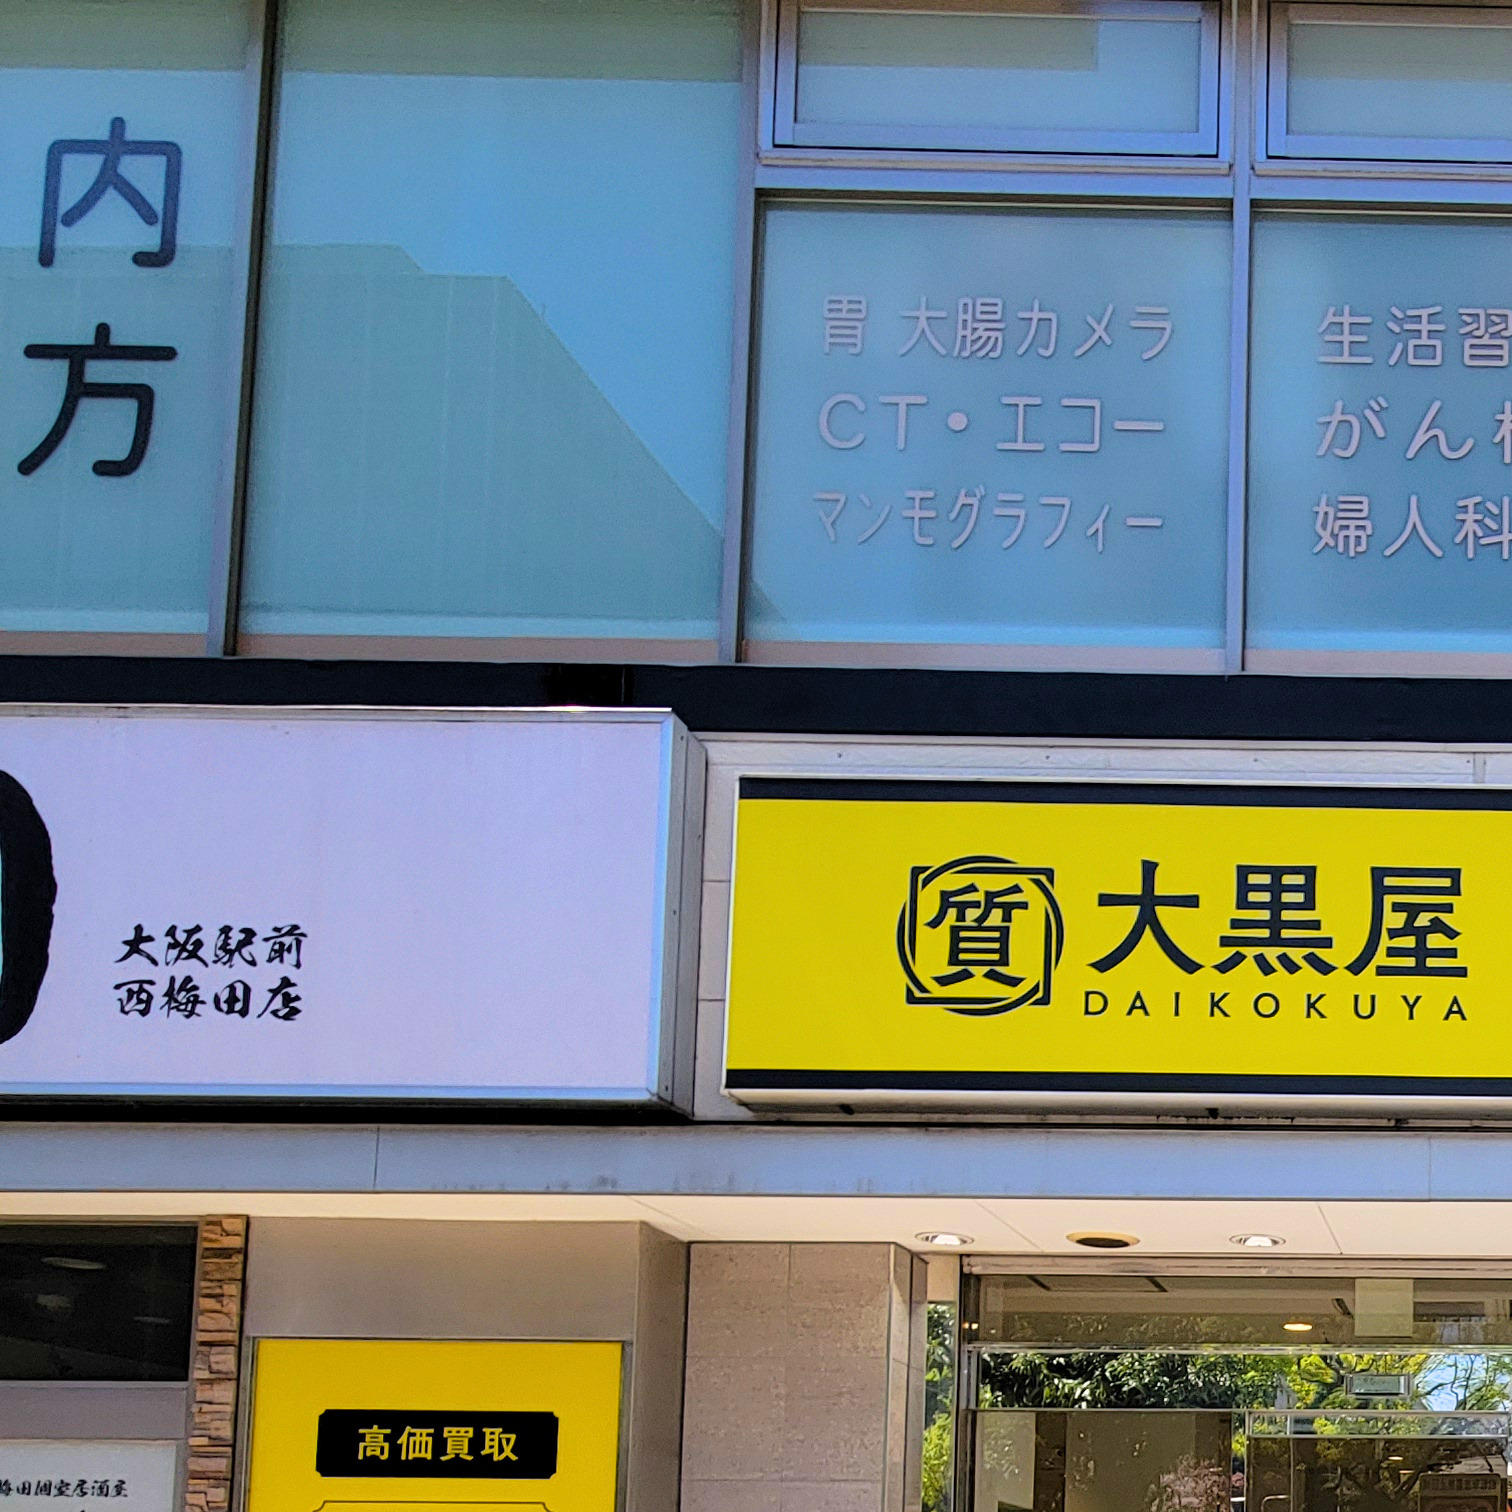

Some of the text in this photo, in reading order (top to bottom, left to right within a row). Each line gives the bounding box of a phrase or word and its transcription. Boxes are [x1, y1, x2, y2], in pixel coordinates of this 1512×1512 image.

[899, 294, 1173, 360] 大腸カメラ
[818, 393, 1166, 453] CT・エコー
[812, 485, 1164, 554] マンモグラフィー
[113, 922, 309, 969] 大阪駅前
[922, 859, 1470, 988] 質 大黒屋
[112, 974, 303, 1022] 西梅田店
[1083, 989, 1468, 1022] DAIKOKUYA
[357, 1424, 520, 1462] 高価買取
